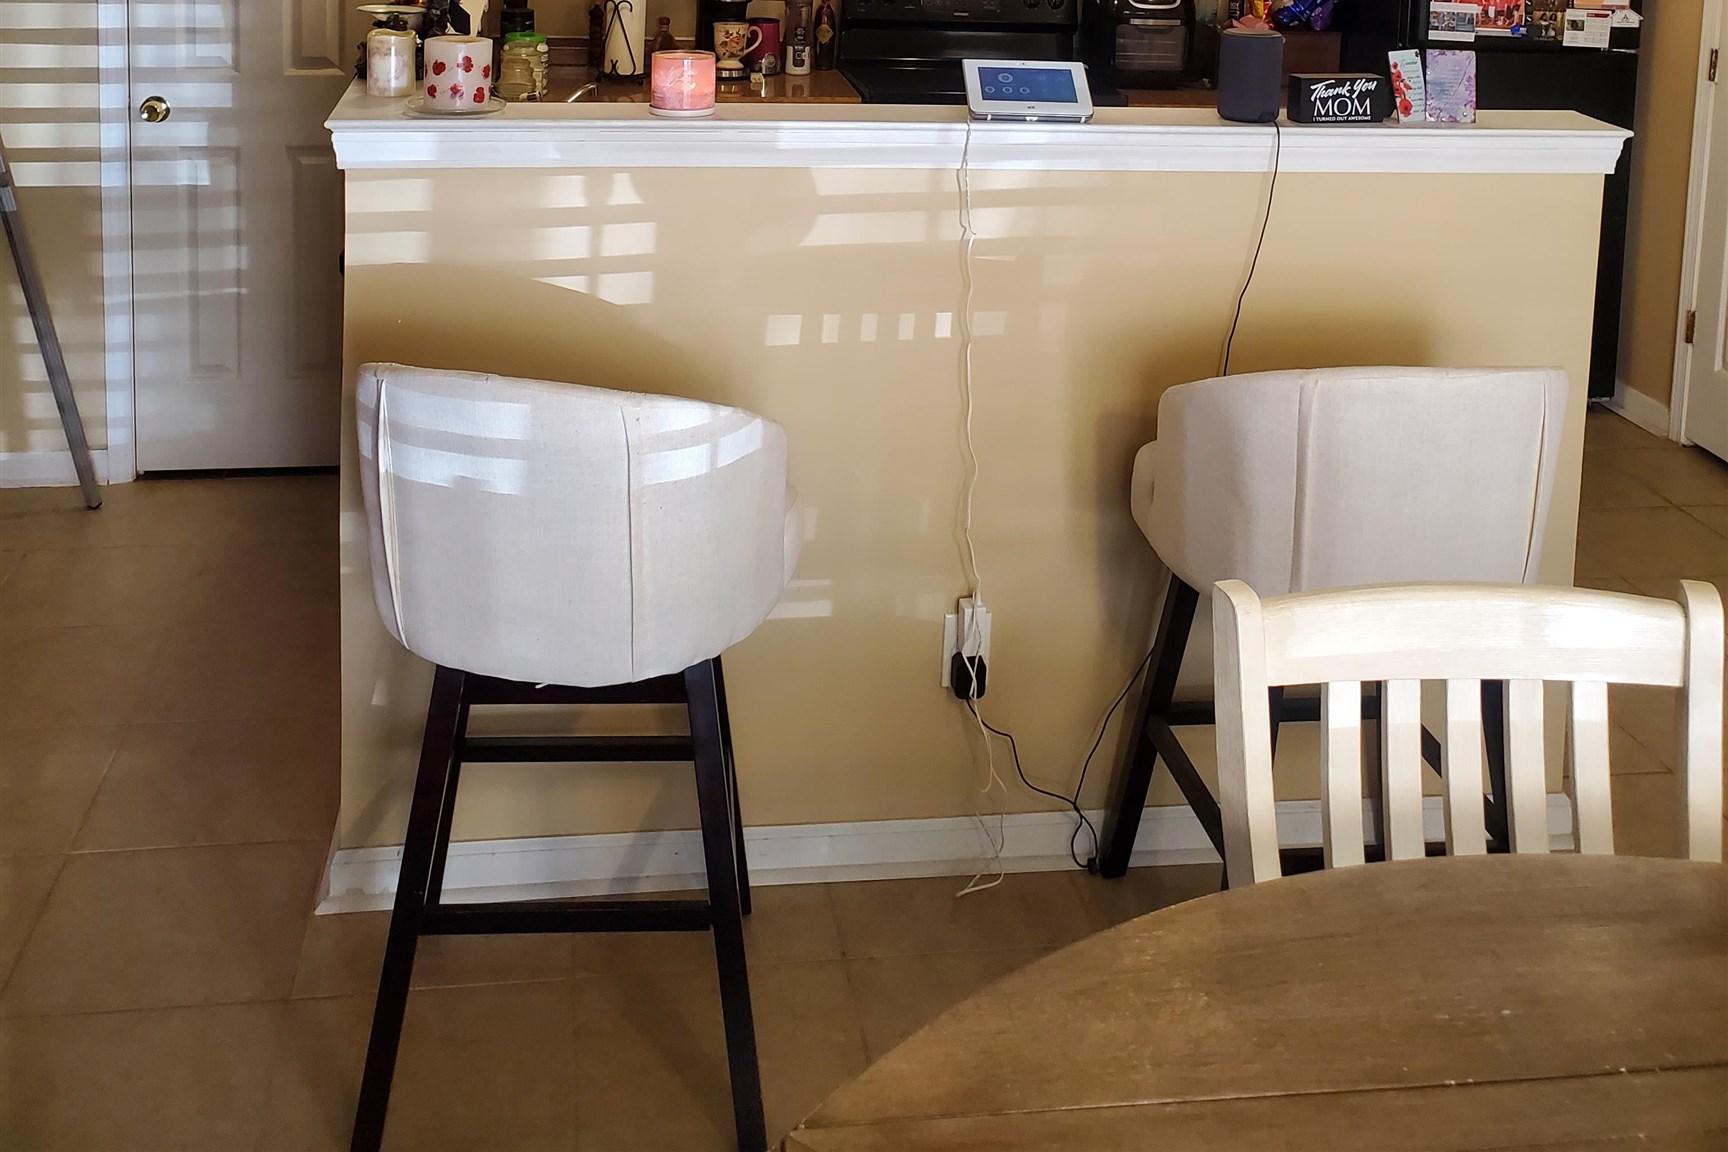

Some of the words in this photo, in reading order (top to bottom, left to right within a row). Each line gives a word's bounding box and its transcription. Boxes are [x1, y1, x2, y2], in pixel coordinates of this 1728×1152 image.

[1310, 79, 1351, 102] Thank
[1351, 78, 1378, 99] You
[1314, 97, 1371, 116] MOM
